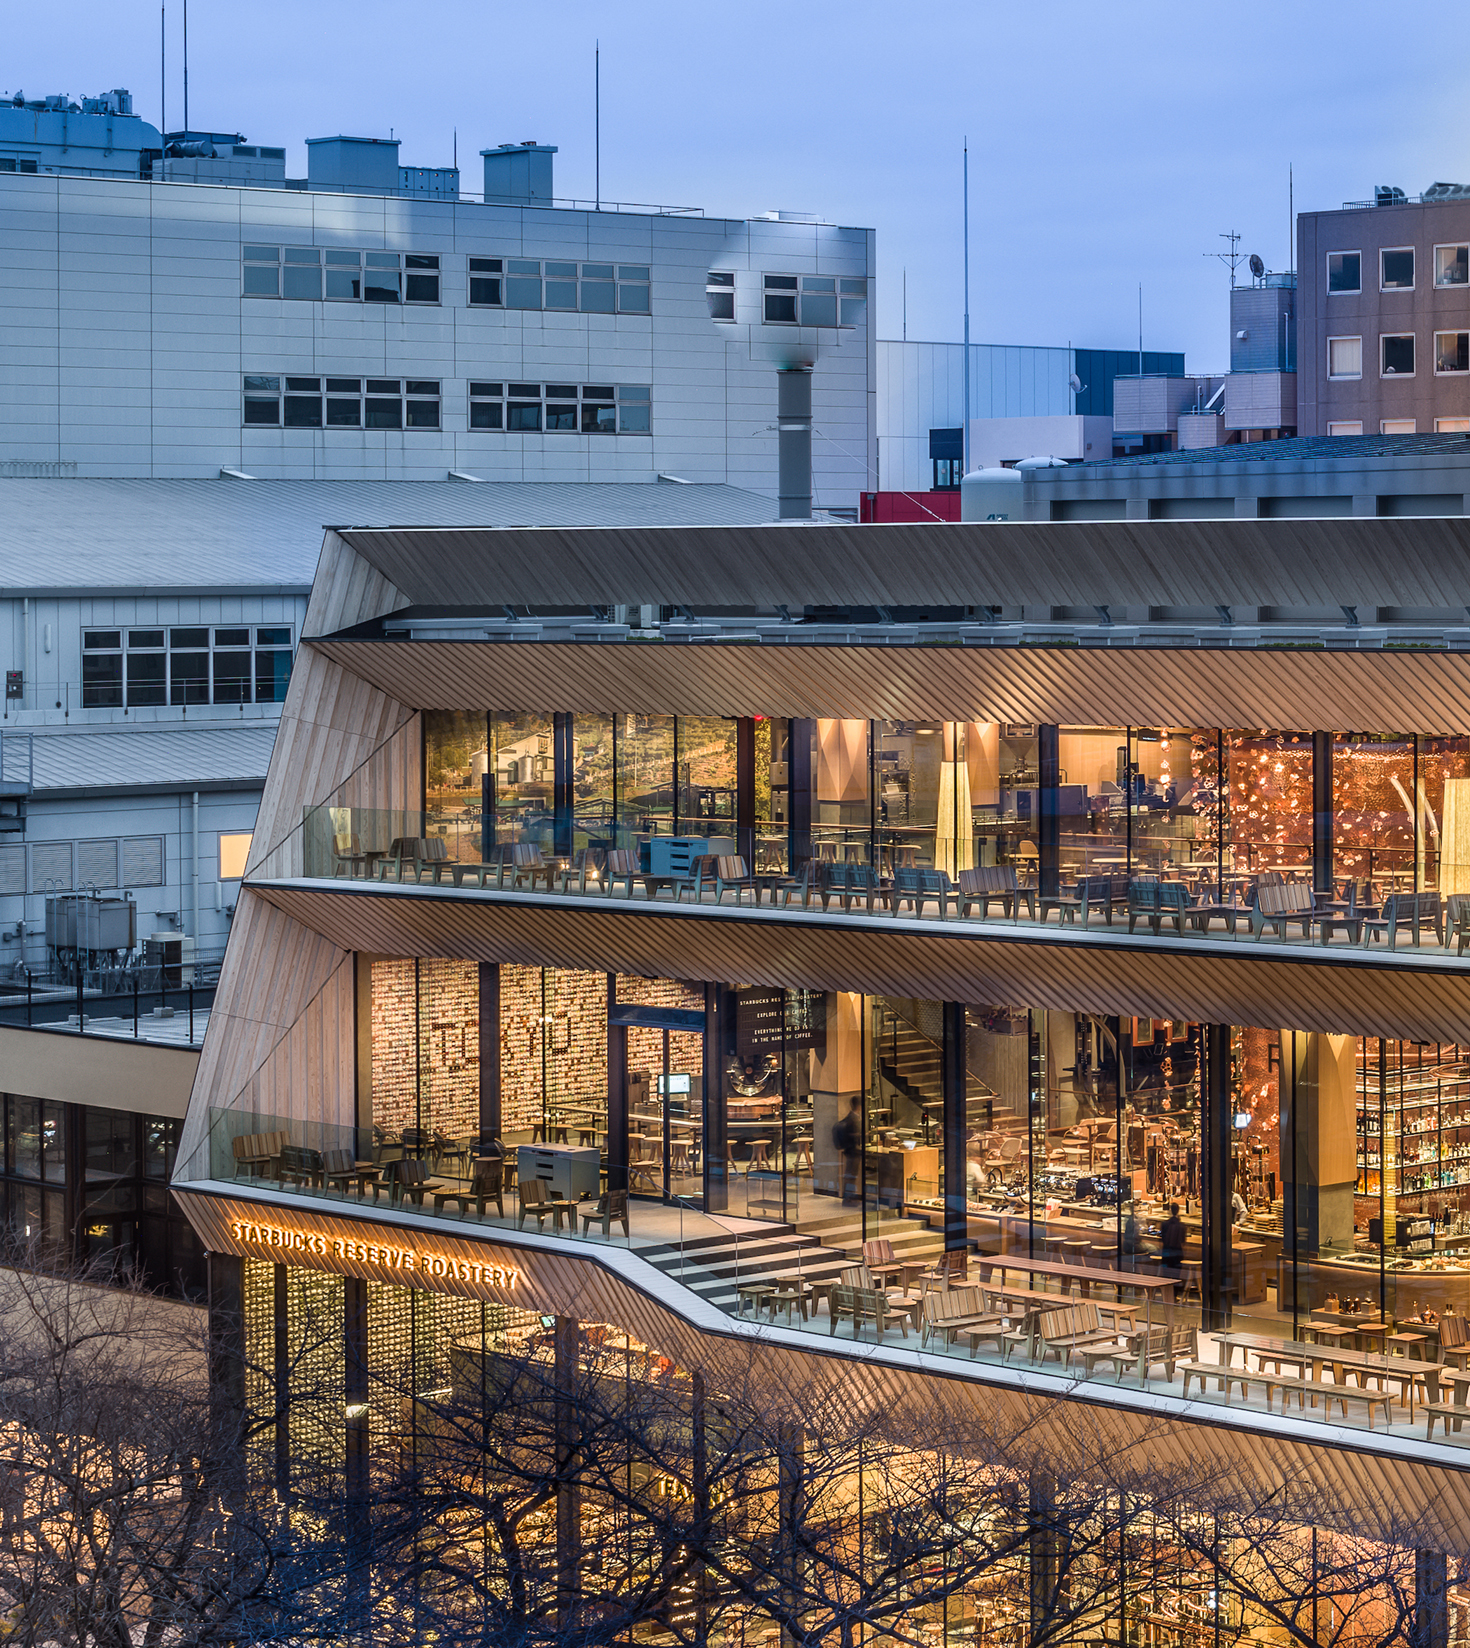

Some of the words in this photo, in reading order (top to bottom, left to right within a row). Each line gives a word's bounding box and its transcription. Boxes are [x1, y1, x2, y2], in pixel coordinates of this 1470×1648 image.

[740, 998, 769, 1006] STARBUCKS
[231, 1222, 327, 1255] STARBUCKS
[333, 1239, 415, 1271] RESERVE
[421, 1256, 519, 1289] ROASTERY
